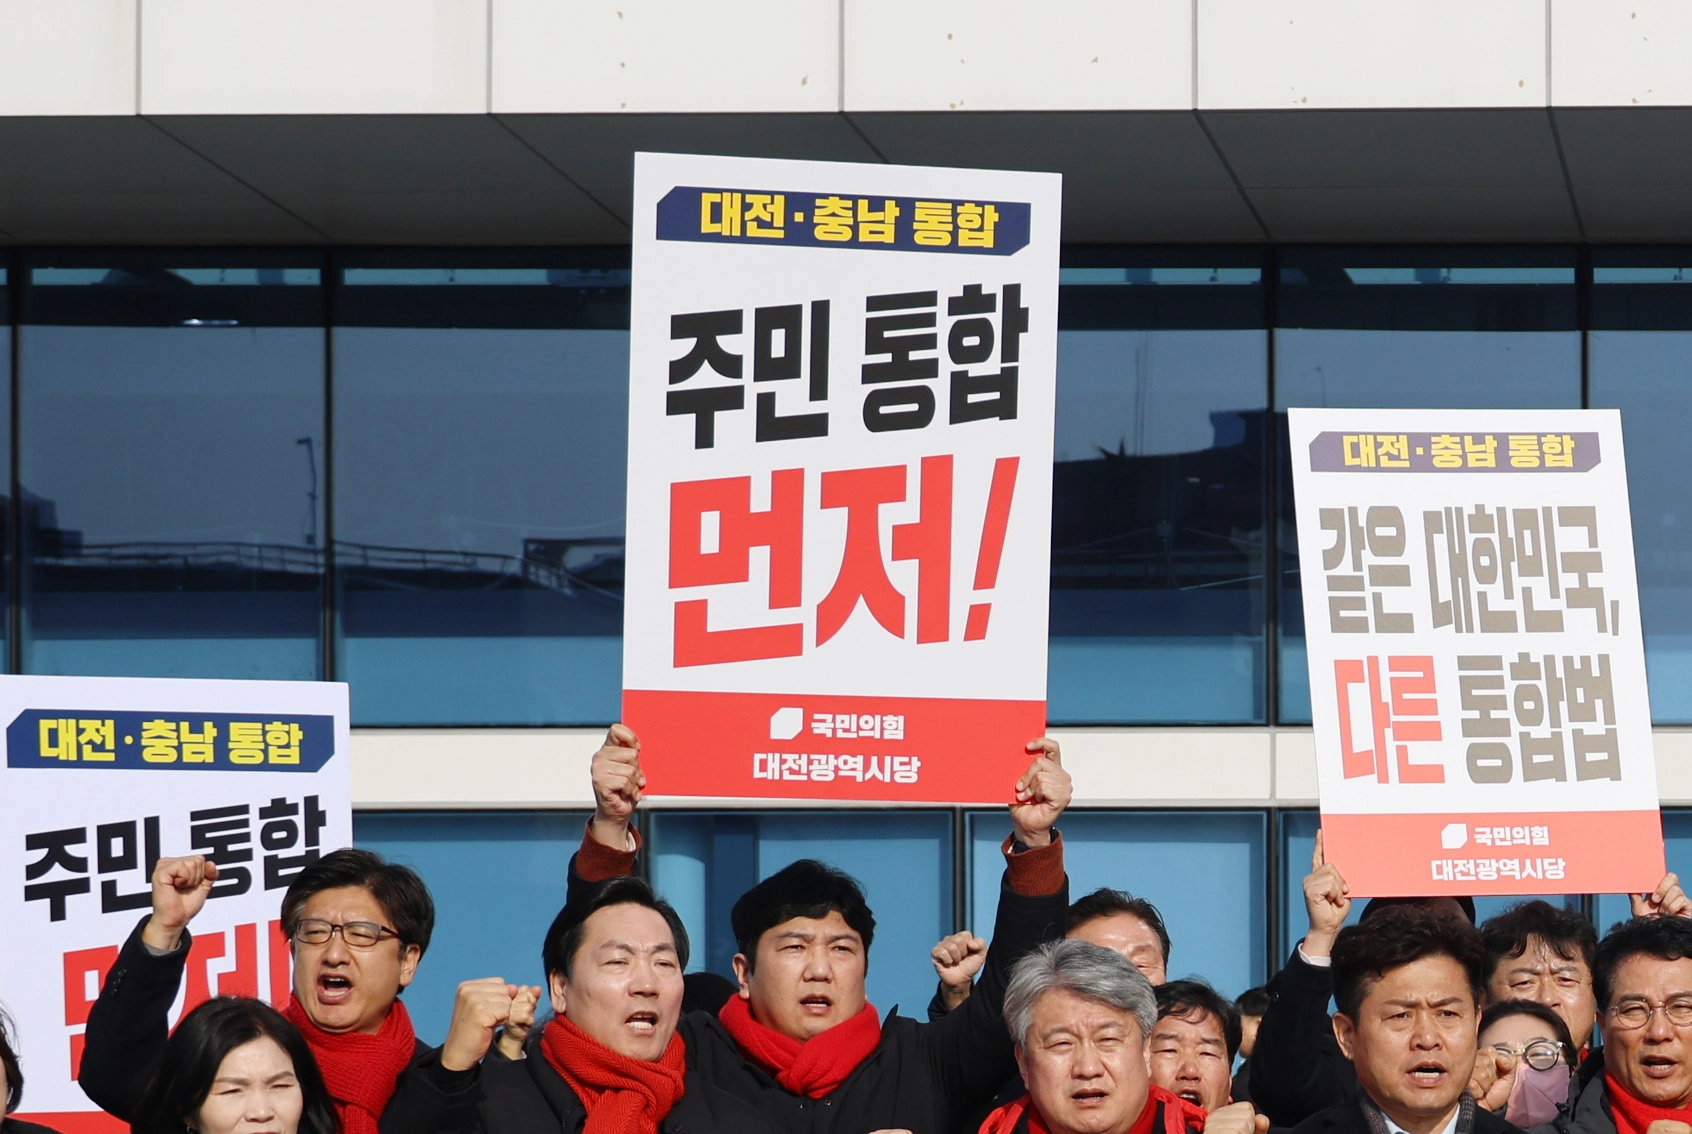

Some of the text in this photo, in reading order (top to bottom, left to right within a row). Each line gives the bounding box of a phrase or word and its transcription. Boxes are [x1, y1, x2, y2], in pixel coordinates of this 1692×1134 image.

[700, 191, 1000, 249] 대전·충남 통합
[665, 283, 1029, 450] 주민 통합
[1342, 433, 1576, 469] 대전·충남 통합
[668, 453, 1020, 669] 먼저!
[1318, 503, 1620, 637] 같은 대한민국,
[38, 718, 304, 765] 대전·충남 통합
[811, 712, 905, 740] 국민의힘
[1334, 651, 1623, 785] 다른 통합법
[752, 752, 922, 784] 대전광역시당
[24, 794, 327, 922] 주민 통합
[1473, 825, 1550, 847] 국민의힘
[1430, 857, 1566, 881] 대전광역시당
